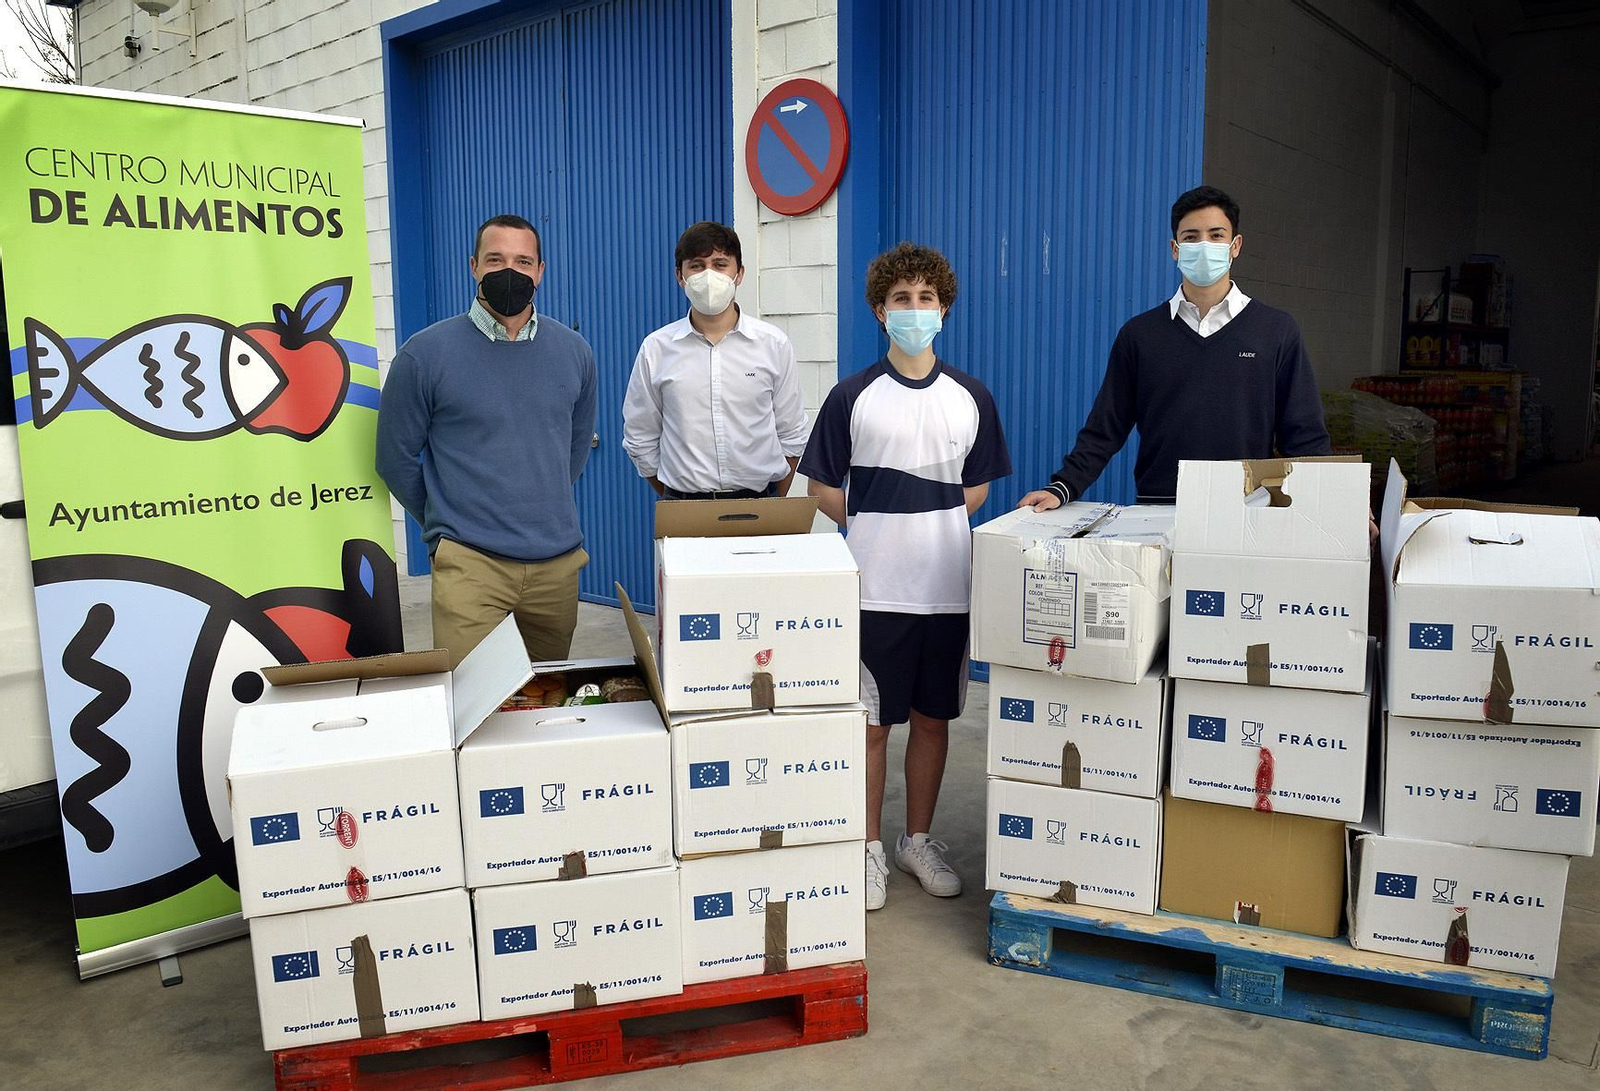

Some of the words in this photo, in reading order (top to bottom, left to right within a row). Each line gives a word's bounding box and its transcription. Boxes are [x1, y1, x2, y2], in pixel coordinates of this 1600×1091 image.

[25, 147, 167, 185] CENTRO
[180, 160, 341, 198] MUNICIPAL
[29, 188, 90, 225] DE
[103, 193, 344, 239] ALIMENTOS
[48, 492, 260, 532] Ayuntamiento
[270, 486, 302, 507] de
[309, 482, 373, 511] Jerez
[1105, 610, 1120, 618] S90
[1279, 603, 1349, 617] FRÁGIL
[776, 617, 842, 630] FRÁGIL
[1515, 634, 1593, 647] FRÁGIL
[1187, 657, 1231, 666] Exportador
[1280, 663, 1343, 674] ES/11/0014/16
[684, 685, 729, 693] Exportador
[779, 679, 839, 688] ES/11/0014/16
[1411, 693, 1460, 702] Exportador
[1516, 698, 1586, 708] ES/11/0014/16
[1082, 714, 1142, 729] FRÁGIL
[1279, 734, 1347, 750] FRÁGIL
[1410, 730, 1476, 741] ES/11/0014/16
[1479, 734, 1528, 744] Autorizado
[1530, 738, 1581, 747] Exportador
[784, 760, 849, 774] FRÁGIL
[1002, 756, 1039, 766] Exportador
[1083, 767, 1137, 780] ES/11/0014/16
[582, 784, 653, 800] FRÁGIL
[1189, 779, 1231, 790] Exportador
[1279, 790, 1341, 804] ES/11/0014/16
[1404, 785, 1477, 800] FRÁGIL
[363, 803, 439, 823] FRÁGIL
[341, 813, 354, 846] TORRENT
[694, 828, 739, 838] Exportador
[741, 823, 785, 834] Autorizado
[787, 818, 846, 829] ES/11/0014/16
[1080, 832, 1140, 848] FRÁGIL
[487, 858, 535, 870] Exportador
[588, 845, 652, 858] ES/11/0014/16
[263, 886, 315, 898] Exportador
[372, 866, 441, 882] ES/11/0014/16
[1000, 872, 1038, 883] Exportador
[1081, 884, 1135, 898] ES/11/0014/16
[785, 885, 849, 901] FRÁGIL
[1473, 891, 1544, 908] FRÁGIL
[594, 918, 663, 936] FRÁGIL
[1373, 933, 1419, 944] Exportador
[380, 942, 454, 961] FRÁGIL
[699, 956, 743, 967] Exportador
[790, 940, 846, 954] ES/11/0014/16
[501, 992, 549, 1003] Exportador
[600, 975, 662, 989] ES/11/0014/16
[284, 1020, 334, 1033] Exportador
[389, 1001, 456, 1017] ES/11/0014/16
